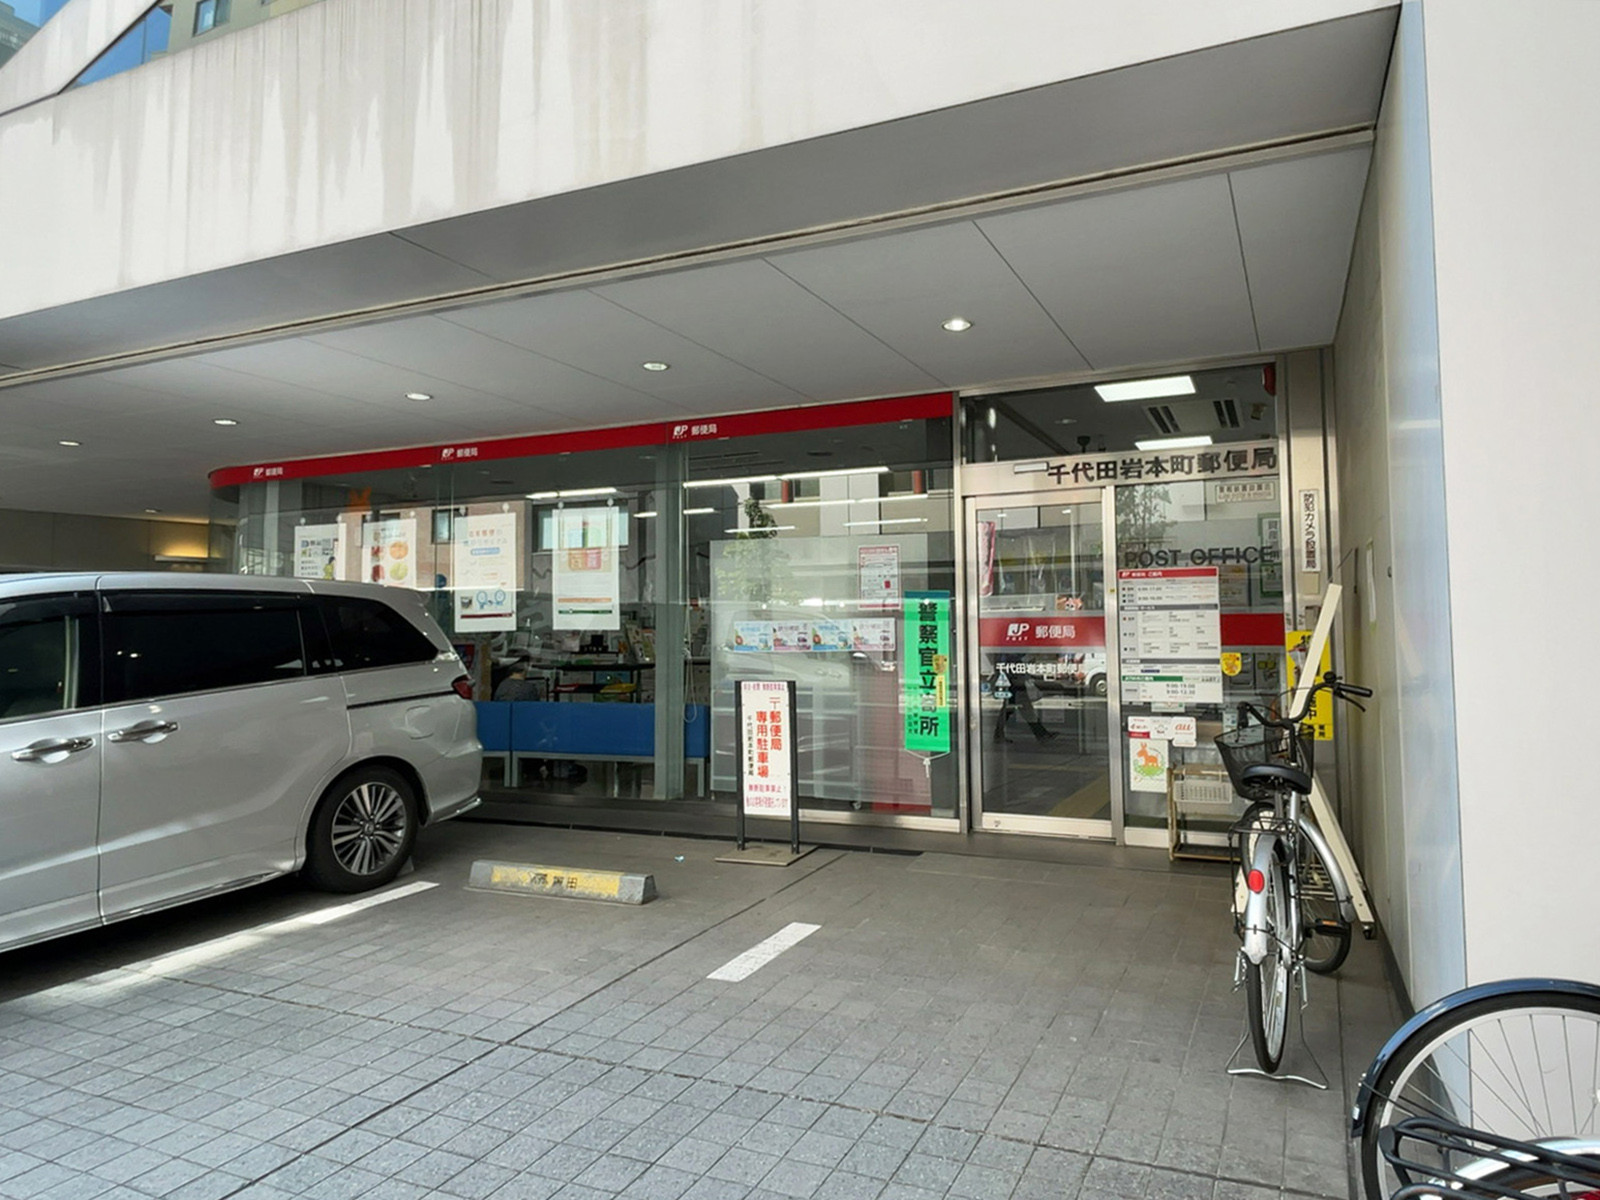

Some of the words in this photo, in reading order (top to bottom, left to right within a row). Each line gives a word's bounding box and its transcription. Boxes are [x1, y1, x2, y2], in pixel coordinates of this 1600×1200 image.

[691, 423, 718, 436] 郵便局
[1047, 446, 1277, 485] 千代田岩本町郵便局
[1303, 493, 1317, 569] 防犯カメラ設置局
[1124, 549, 1182, 569] POST
[1190, 546, 1275, 566] OFFICE
[1035, 625, 1076, 639] 郵便局
[917, 601, 939, 737] 警察官立寄所
[1174, 723, 1192, 731] au
[756, 710, 769, 778] 専用駐車場
